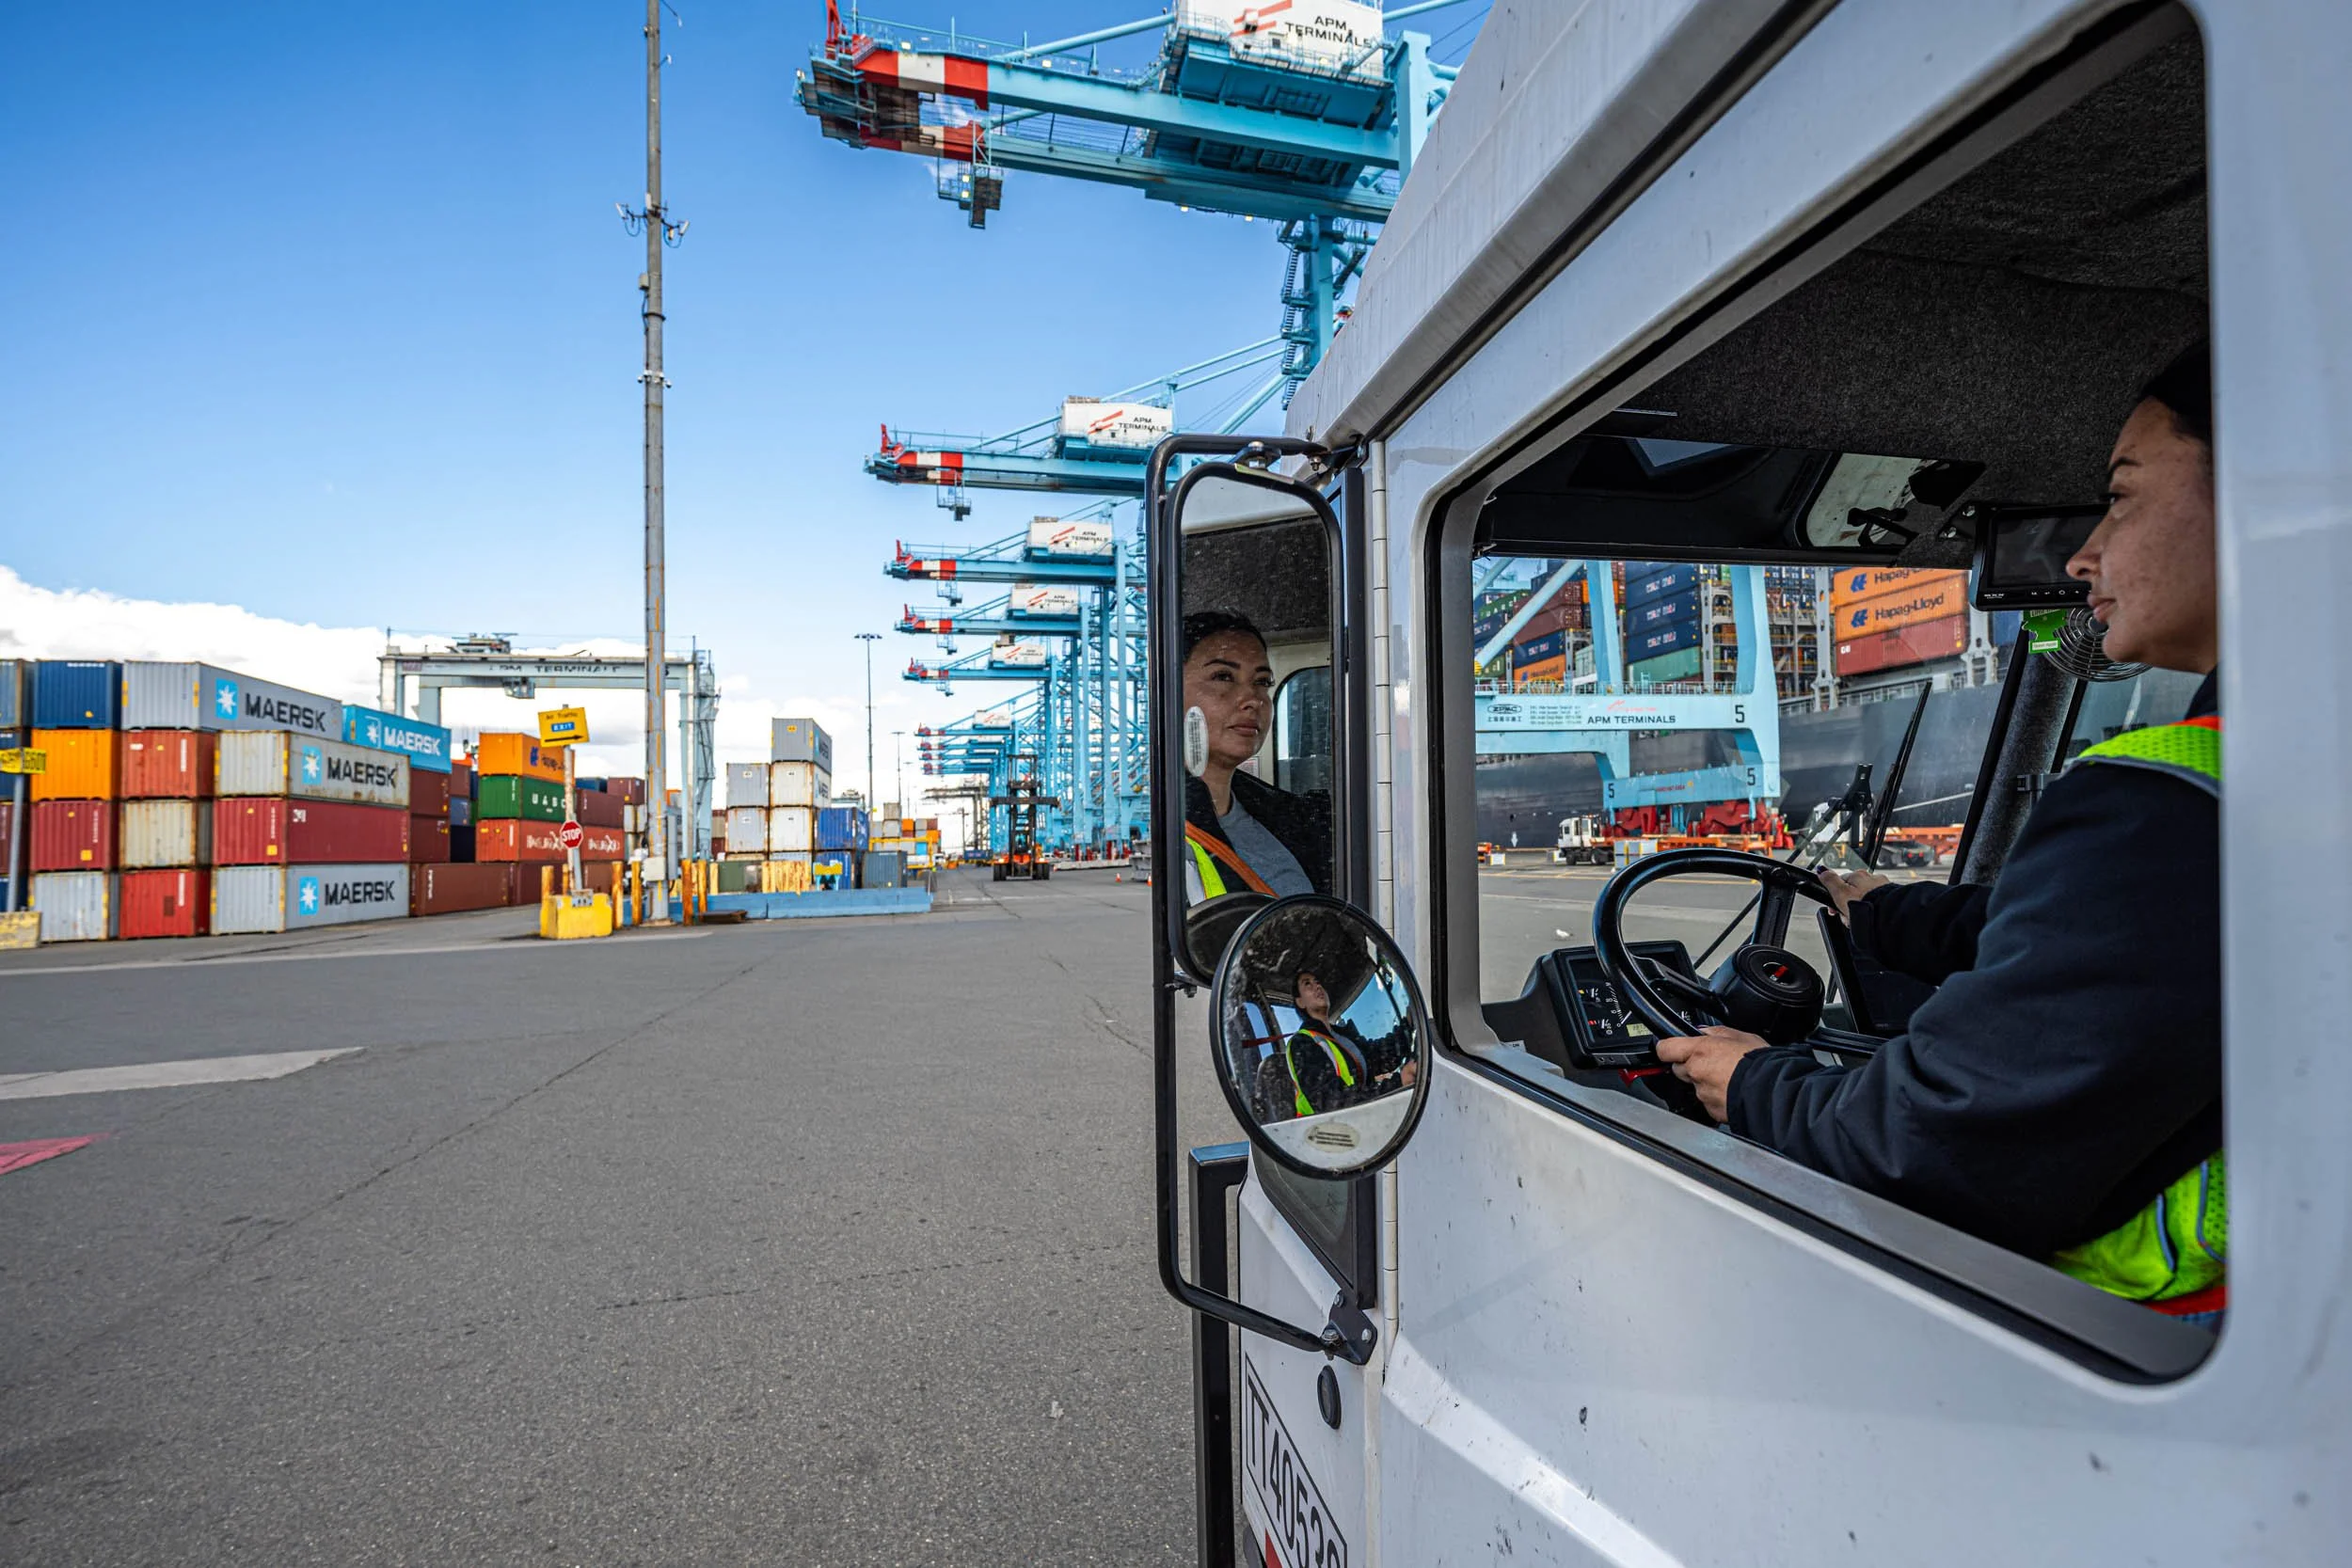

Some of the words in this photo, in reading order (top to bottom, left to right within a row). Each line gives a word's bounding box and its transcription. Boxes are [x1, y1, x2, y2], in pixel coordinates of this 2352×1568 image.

[1314, 16, 1346, 30] APM
[1284, 22, 1372, 48] TERMINALS
[1119, 422, 1167, 432] TERMINALS
[1874, 593, 1945, 621] Hapag-Lloyd
[246, 692, 326, 732] MAERSK
[1735, 705, 1745, 723] 5
[553, 722, 573, 731] EXIT
[384, 726, 441, 756] MAERSK
[327, 756, 397, 789] MAERSK
[1746, 768, 1756, 786] 5
[1608, 783, 1614, 799] 5
[563, 828, 581, 841] STOP
[325, 879, 396, 906] MAERSK
[1248, 1374, 1341, 1568] TT4053
